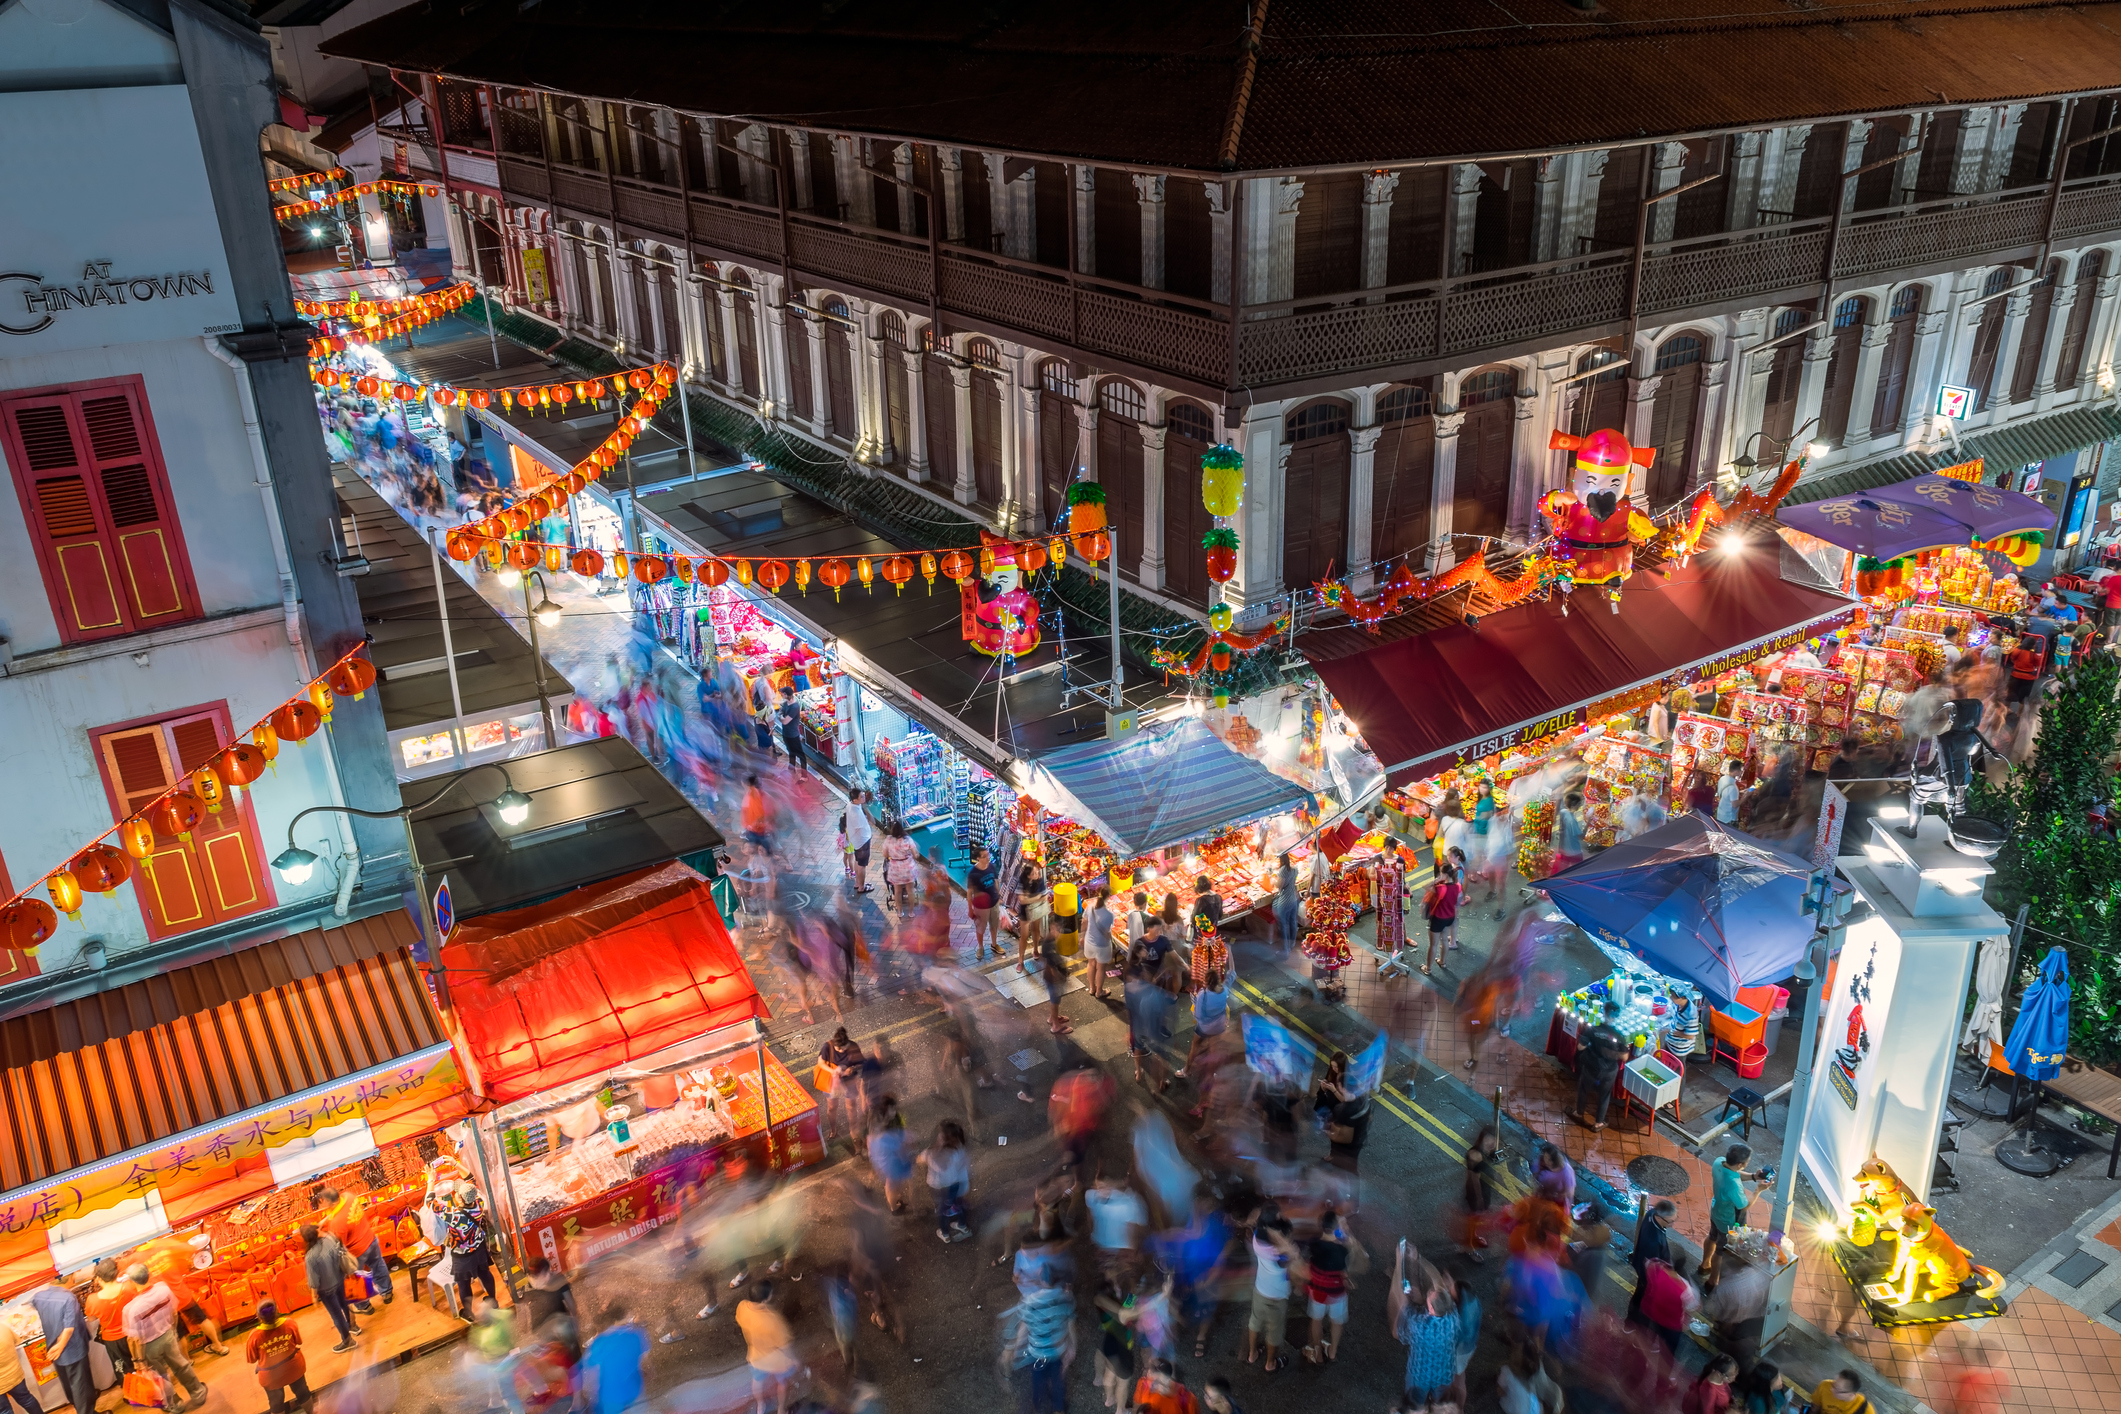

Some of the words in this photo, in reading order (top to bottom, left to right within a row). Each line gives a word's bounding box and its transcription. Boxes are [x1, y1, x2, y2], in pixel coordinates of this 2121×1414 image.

[83, 260, 112, 281] AT
[0, 271, 215, 335] CHINATOWN
[203, 323, 242, 334] 2008/0031
[1700, 648, 1757, 678] Wholesale
[1760, 641, 1770, 656] &
[1774, 628, 1806, 651] Retail
[1472, 732, 1517, 760] LESLIE
[1521, 710, 1577, 742] JAVELLE
[1598, 926, 1618, 942] Tiger
[2026, 1047, 2048, 1064] Tiger
[121, 1068, 426, 1194] 全美香水与化妆品
[586, 1230, 630, 1258] NATURAL
[629, 1217, 658, 1238] DRIED
